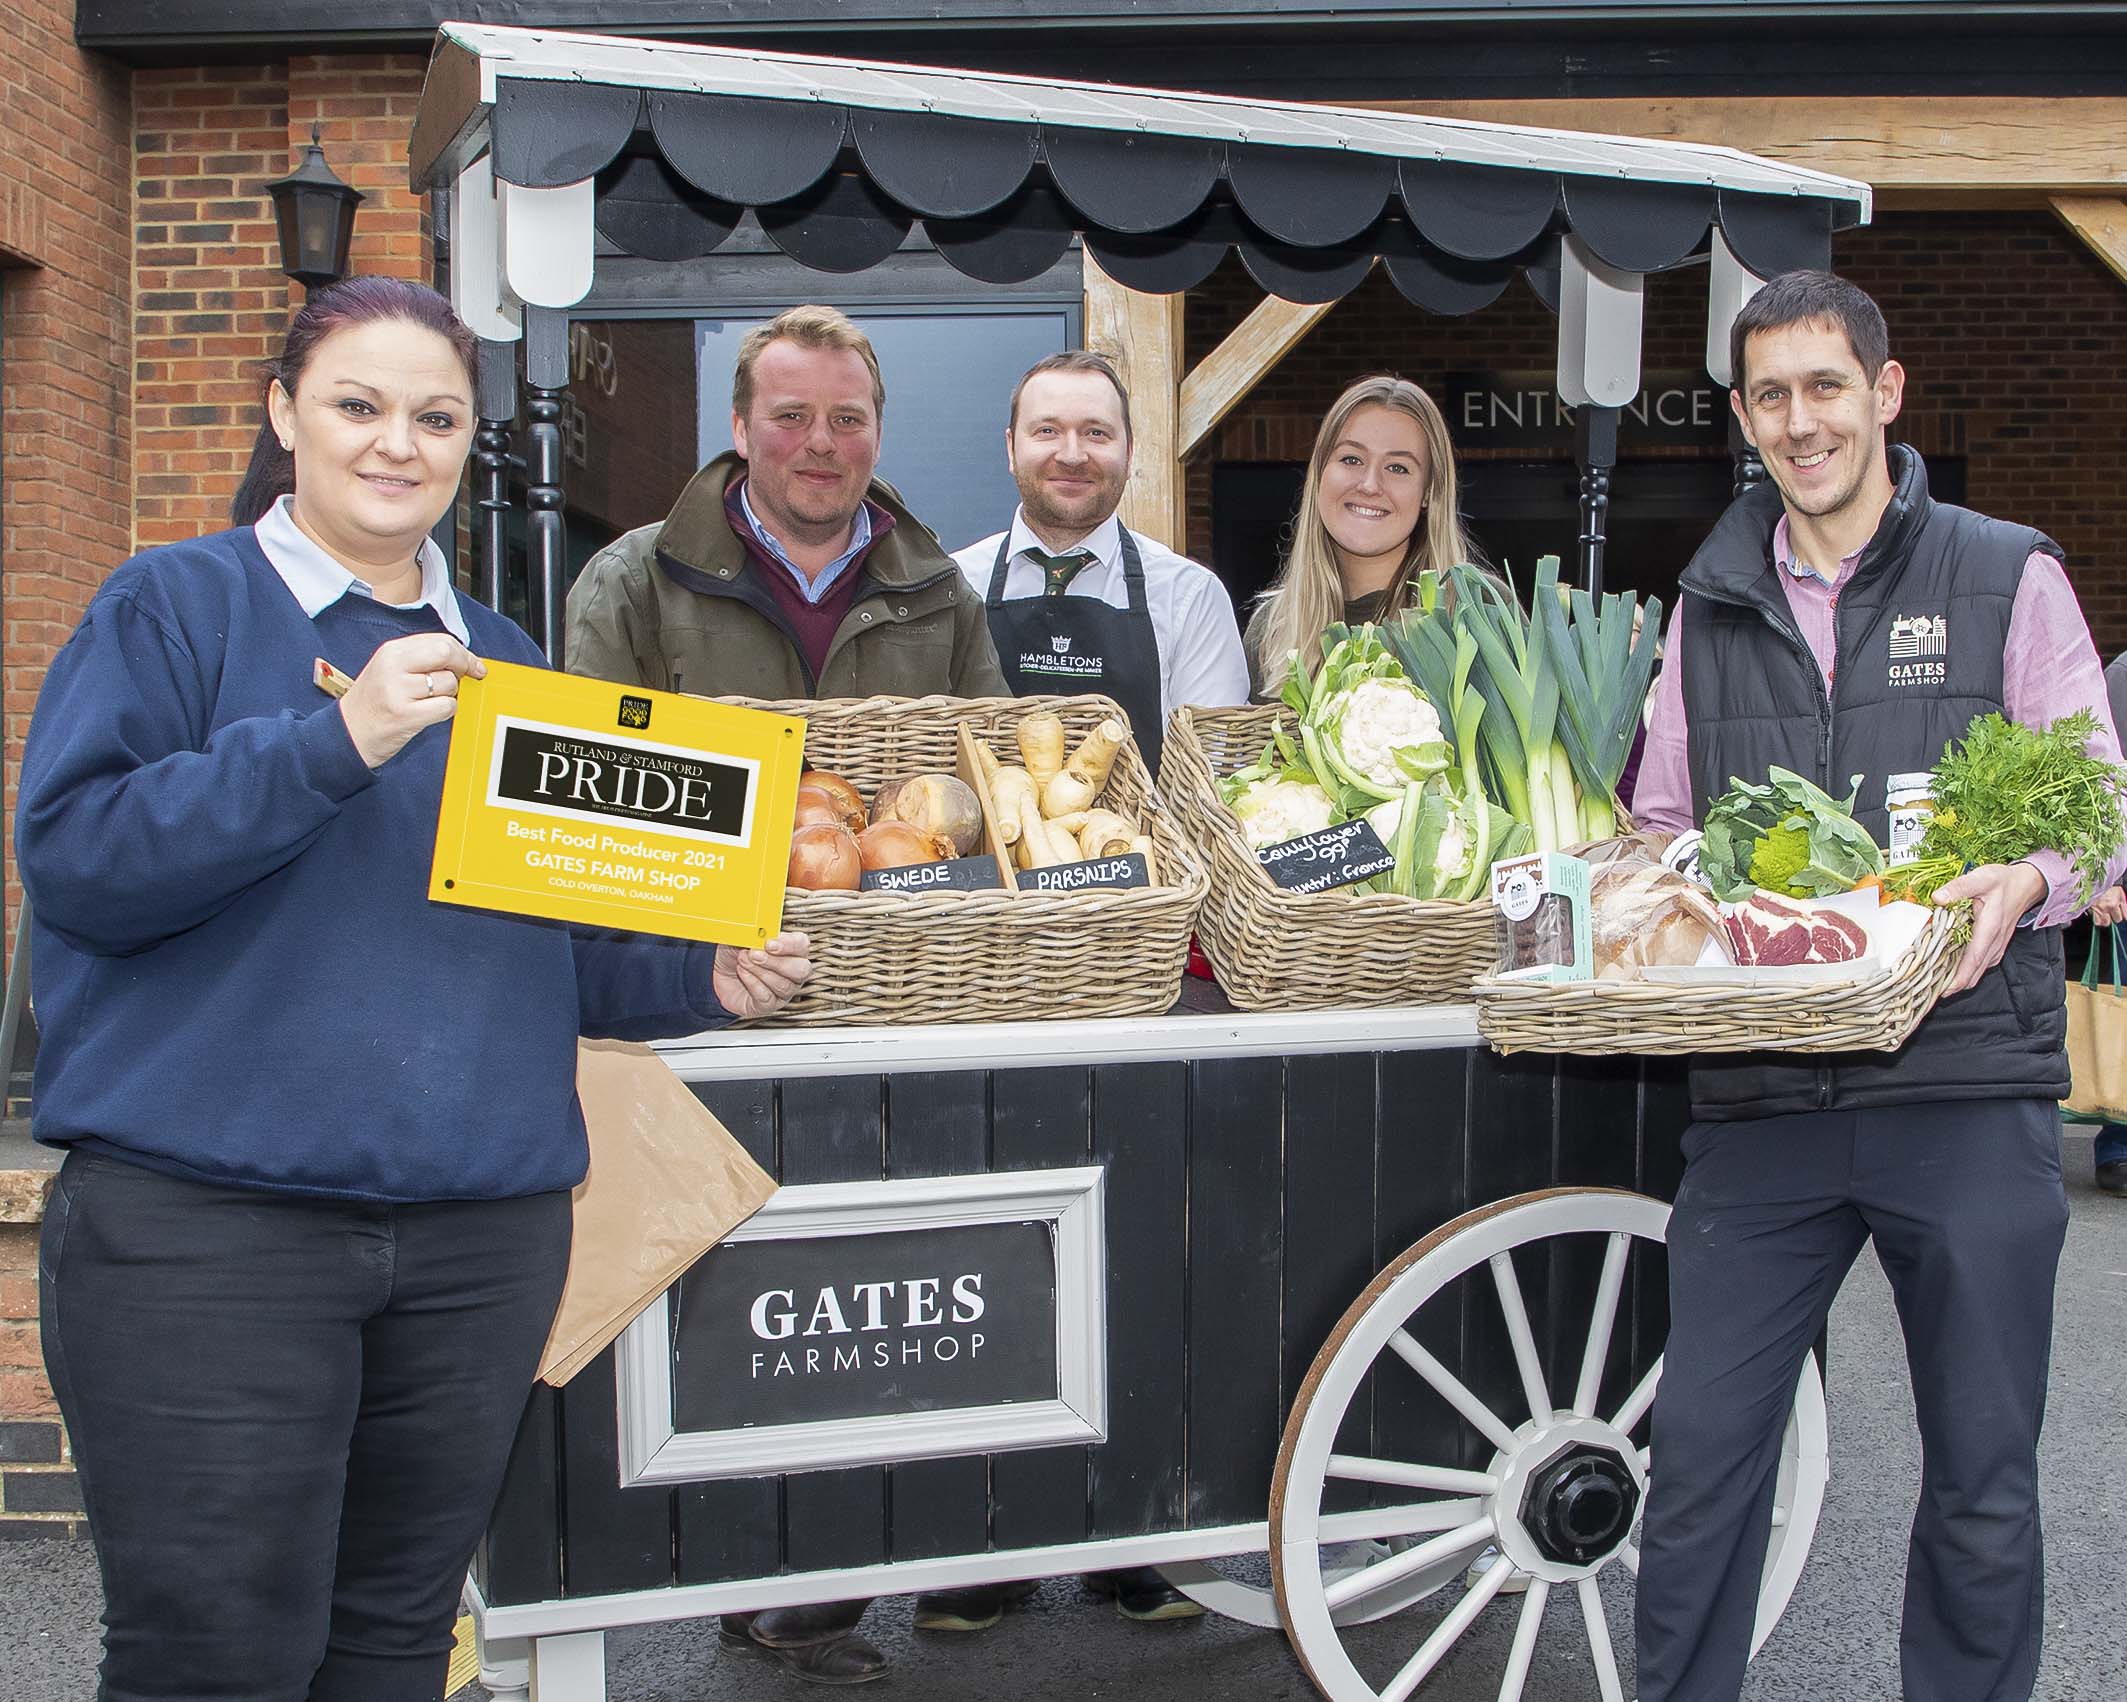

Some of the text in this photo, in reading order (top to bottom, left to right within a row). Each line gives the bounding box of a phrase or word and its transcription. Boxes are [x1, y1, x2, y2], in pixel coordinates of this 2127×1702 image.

[1464, 390, 1711, 427] ENTRNCE
[1020, 653, 1102, 667] HAMBLETONS
[1888, 662, 1945, 678] GATES
[1888, 676, 1945, 687] FARMSHOP
[554, 742, 703, 777] RUTLAND & STAMFORD
[534, 752, 712, 821] PRIDE
[506, 821, 725, 870] Best Food Producer 2021
[525, 850, 701, 891] GATES FARM SHOP
[879, 865, 951, 890] SWEDE
[1037, 859, 1132, 890] PARSNIPS
[1342, 856, 1396, 880] France
[548, 877, 576, 889] COLD
[629, 890, 674, 905] OAKHAM
[750, 1273, 985, 1340] GATES
[752, 1333, 985, 1378] FARMSHOP
